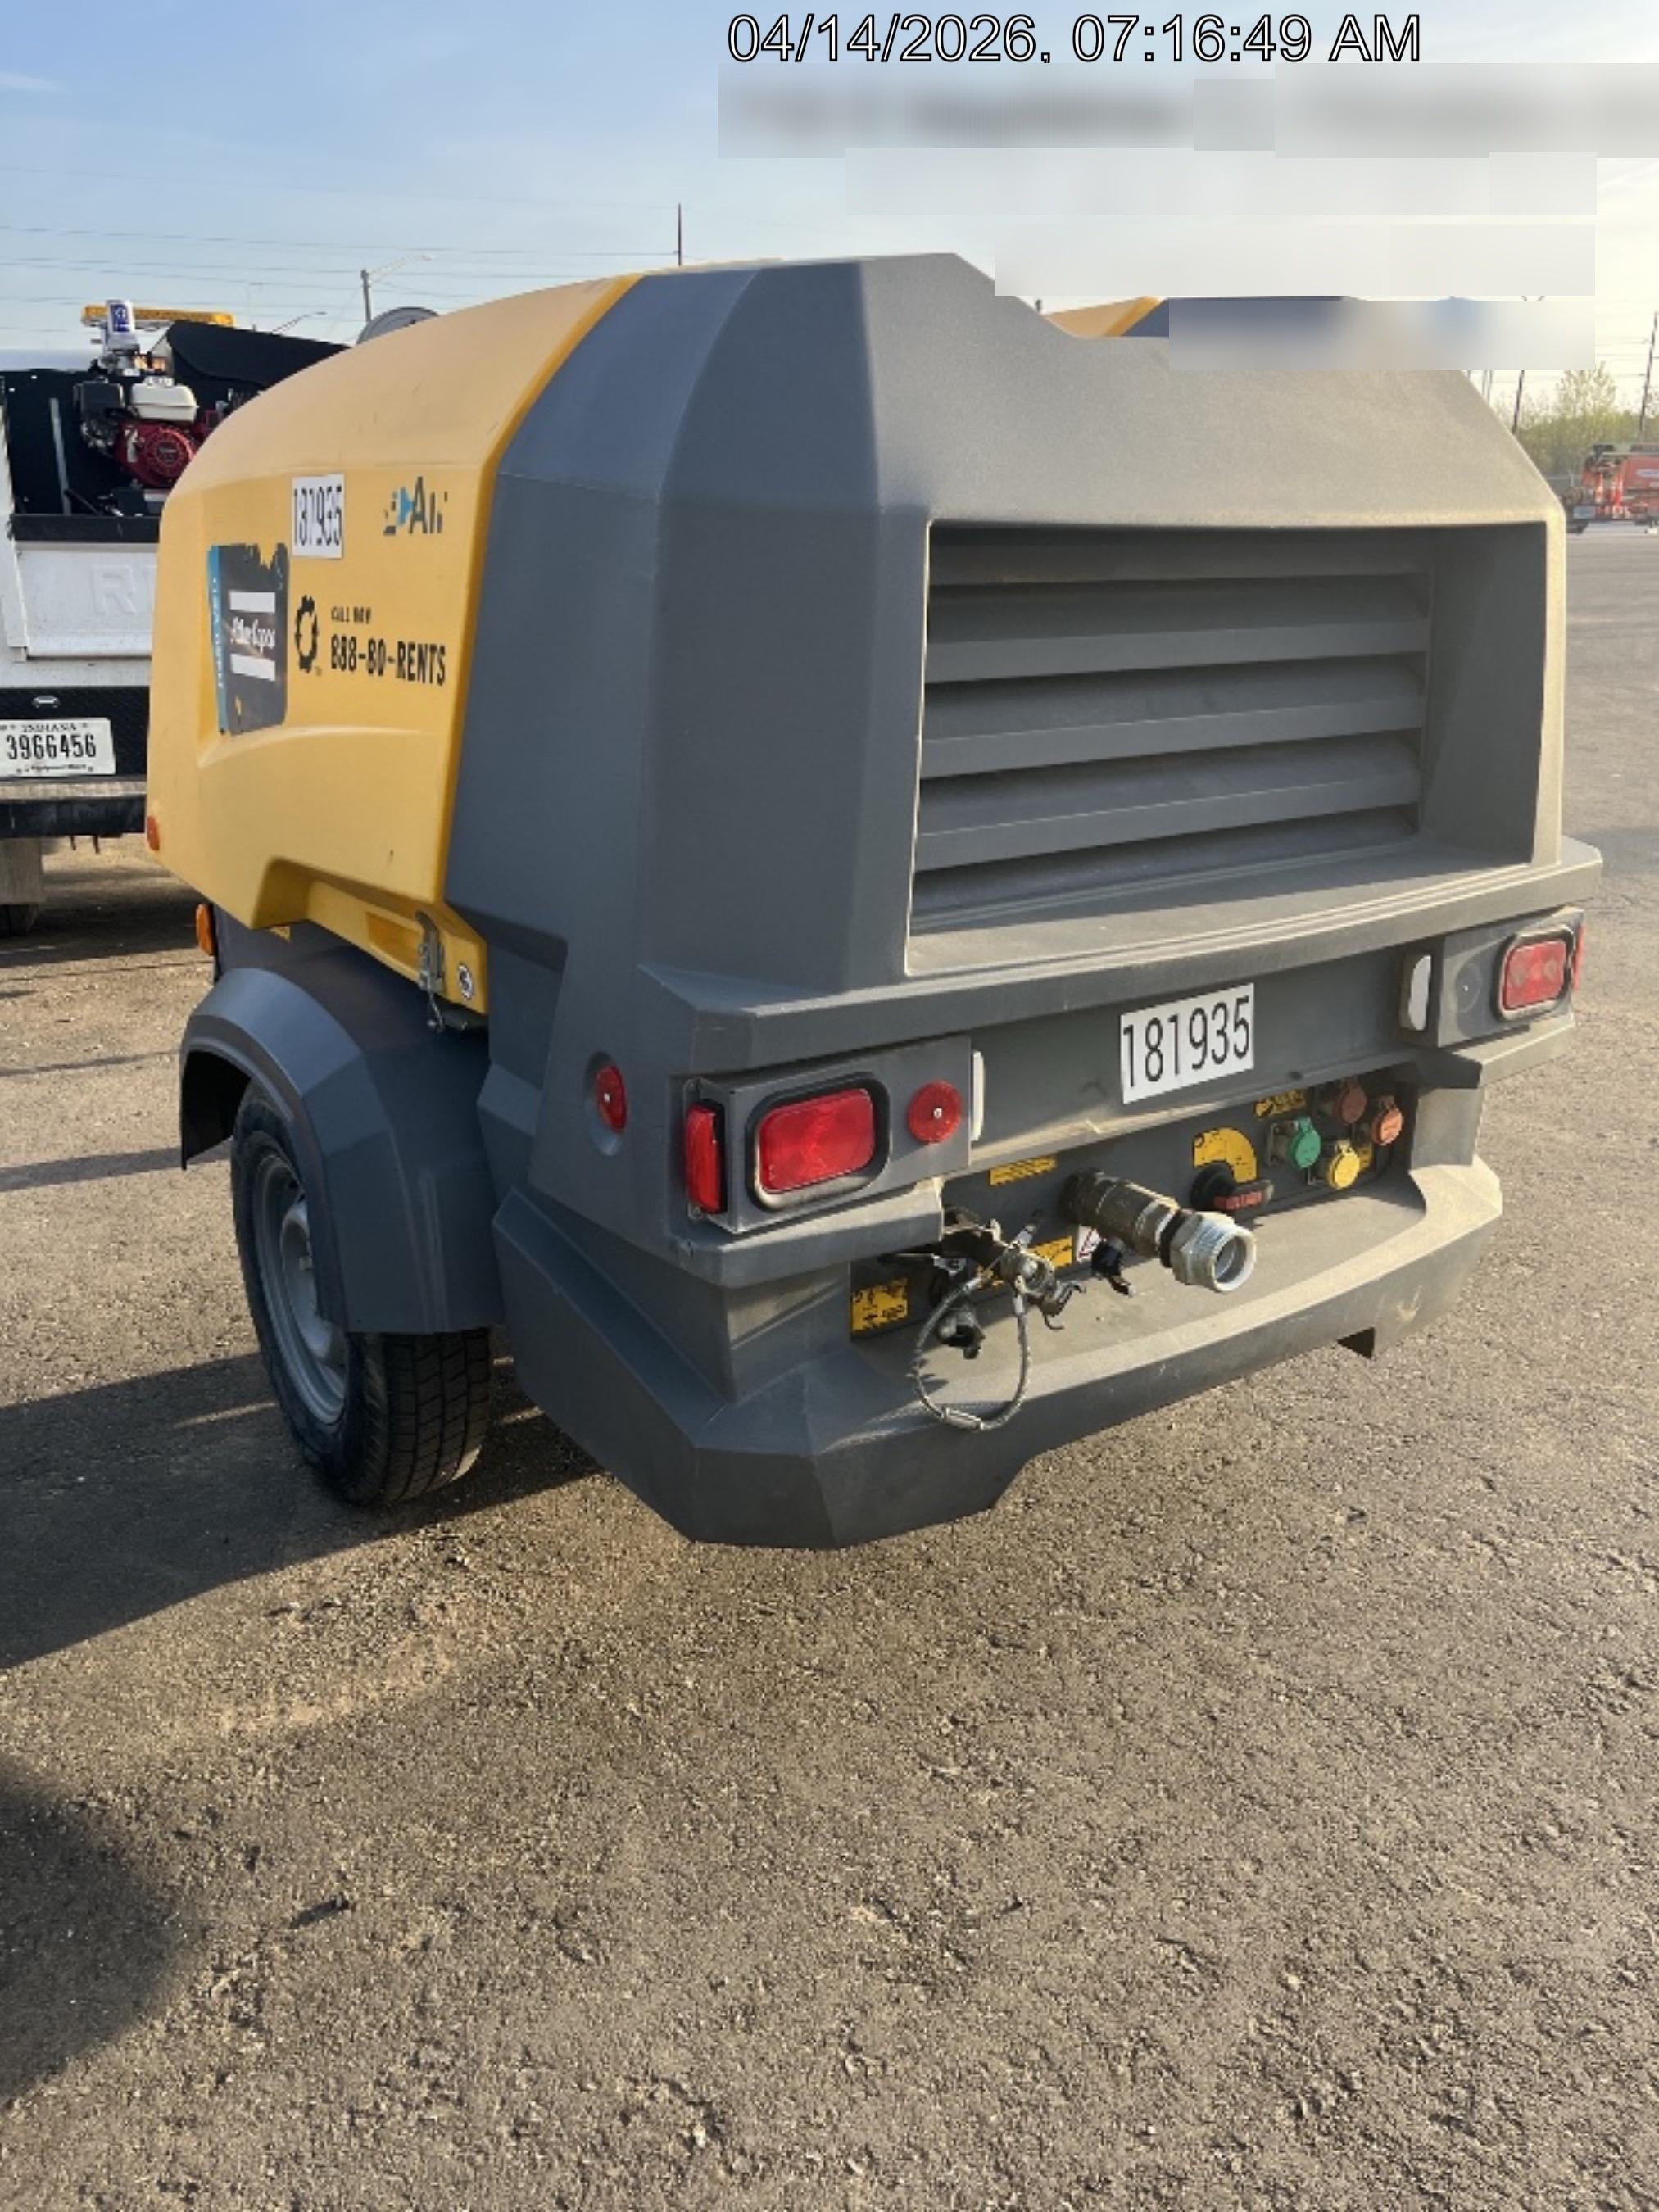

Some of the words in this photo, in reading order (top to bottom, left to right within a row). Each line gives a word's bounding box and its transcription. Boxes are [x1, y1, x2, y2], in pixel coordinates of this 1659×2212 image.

[331, 633, 446, 687] 888-80-RENTS
[6, 733, 97, 760] 3966456
[1122, 995, 1249, 1087] 181935
